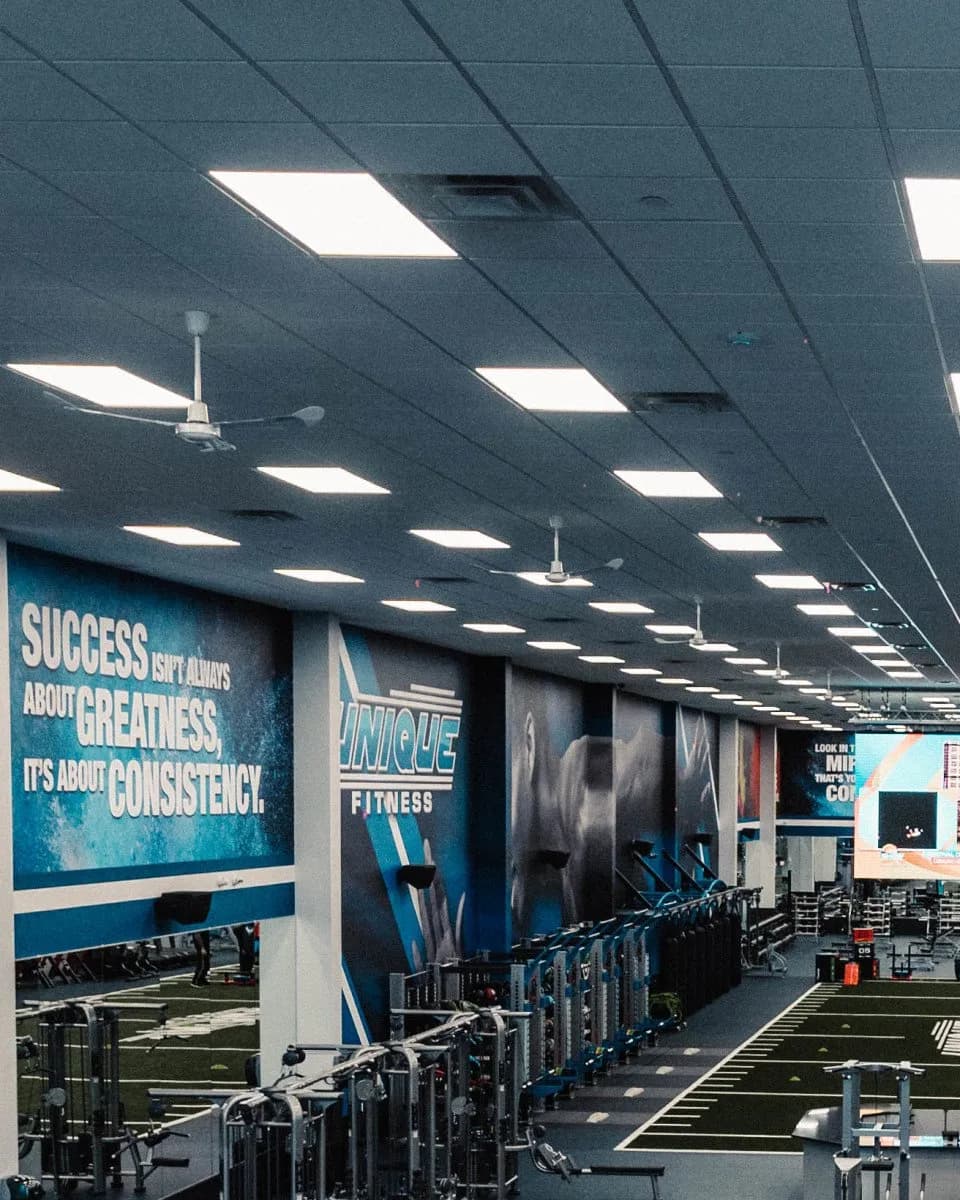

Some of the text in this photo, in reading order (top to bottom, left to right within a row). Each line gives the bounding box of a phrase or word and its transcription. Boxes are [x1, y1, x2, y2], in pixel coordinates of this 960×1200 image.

[22, 602, 231, 690] SUCCESS ISN'T ALWAYS
[23, 681, 222, 760] ABOUT GREATNESS,
[339, 701, 461, 774] UNIQUE
[815, 744, 838, 752] LOOK
[839, 744, 848, 752] IN
[23, 757, 265, 818] IT'S ABOUT CONSISTENCY.
[351, 790, 433, 815] FITNESS
[815, 773, 843, 783] THAT'S
